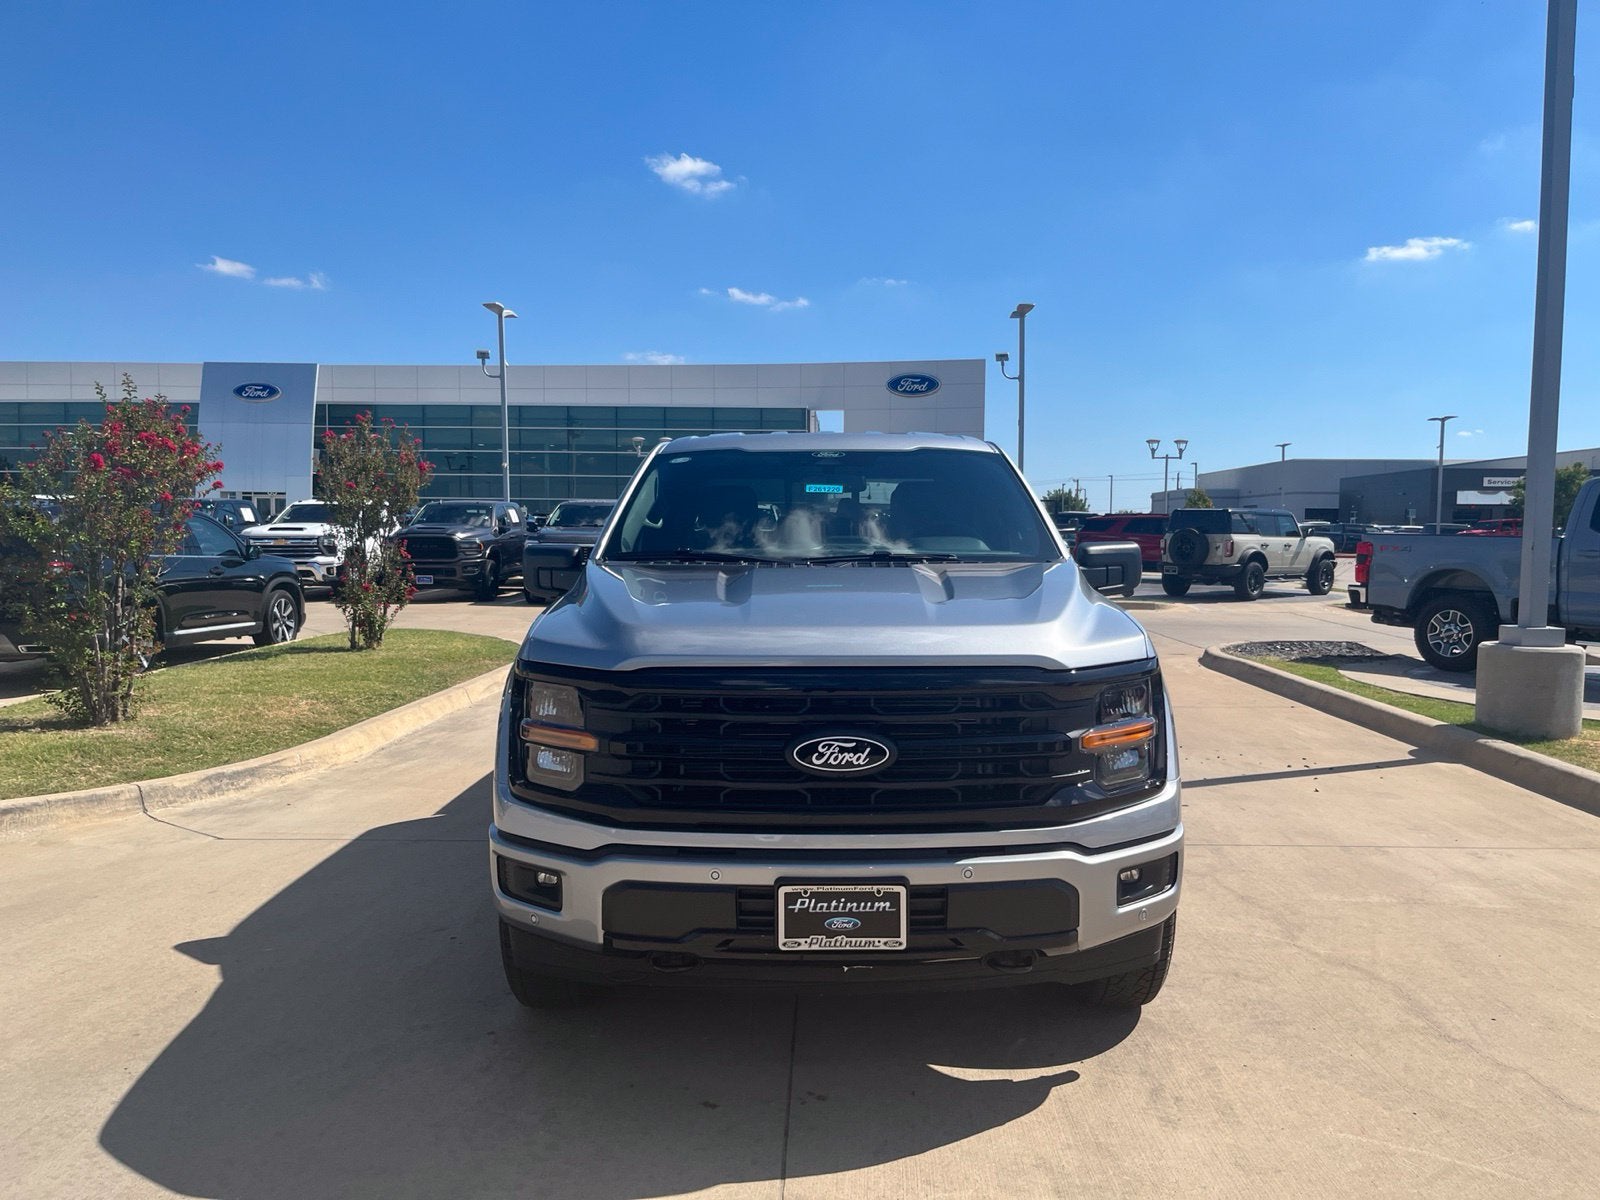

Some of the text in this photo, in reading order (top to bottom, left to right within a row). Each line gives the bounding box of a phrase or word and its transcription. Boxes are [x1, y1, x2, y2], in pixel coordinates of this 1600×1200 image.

[897, 378, 928, 391] Ford
[242, 385, 269, 397] Ford
[811, 741, 871, 765] Ford
[787, 898, 896, 913] Platinum
[831, 919, 854, 928] Ford
[808, 937, 881, 948] Platinum
